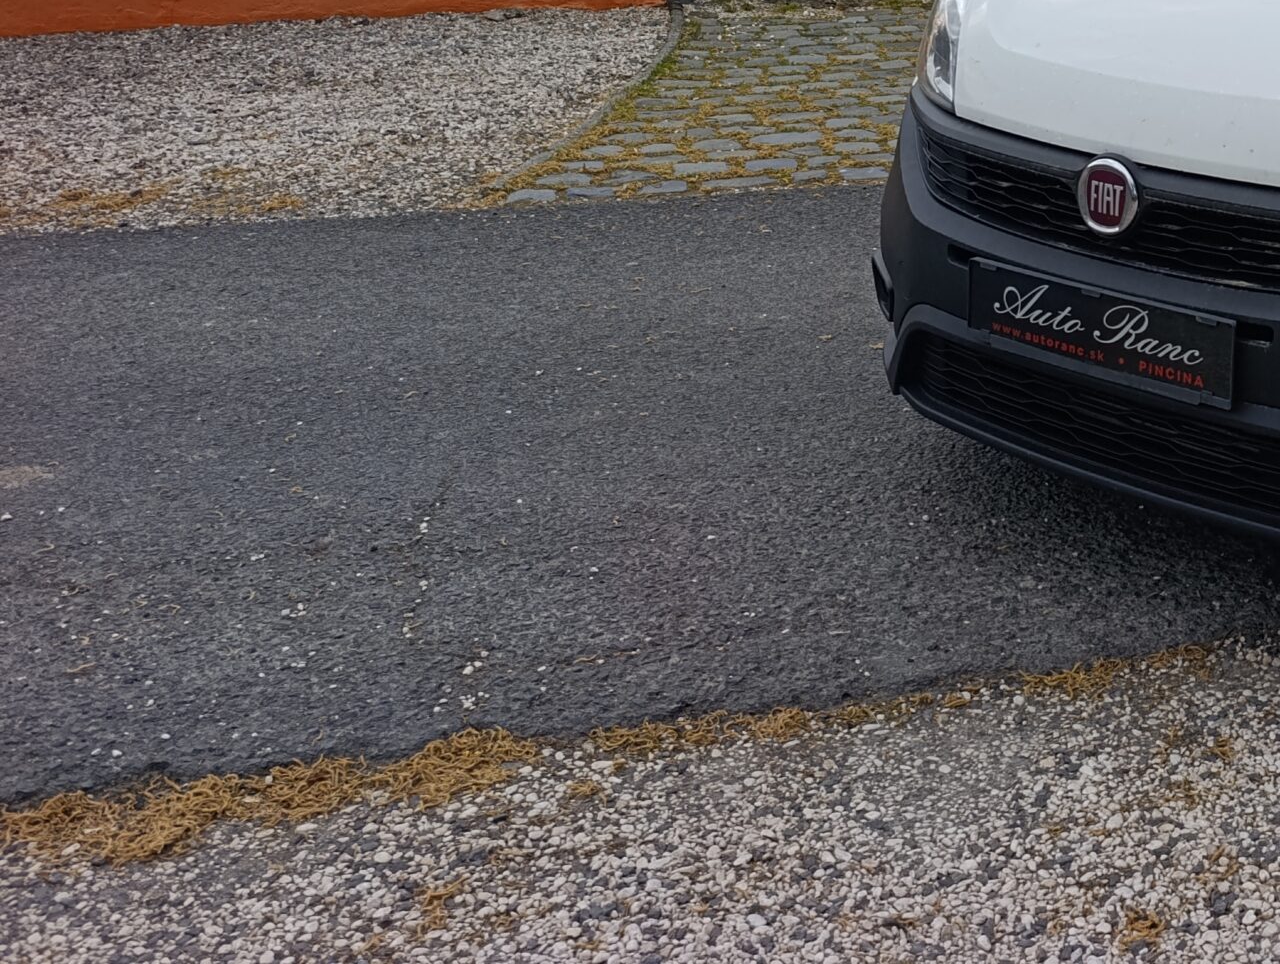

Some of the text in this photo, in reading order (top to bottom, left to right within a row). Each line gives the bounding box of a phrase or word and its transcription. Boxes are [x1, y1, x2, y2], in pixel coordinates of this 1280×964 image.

[1090, 180, 1124, 217] FIAT
[992, 322, 1105, 362] www.autoranc.sk
[993, 285, 1204, 366] Auto Ranc
